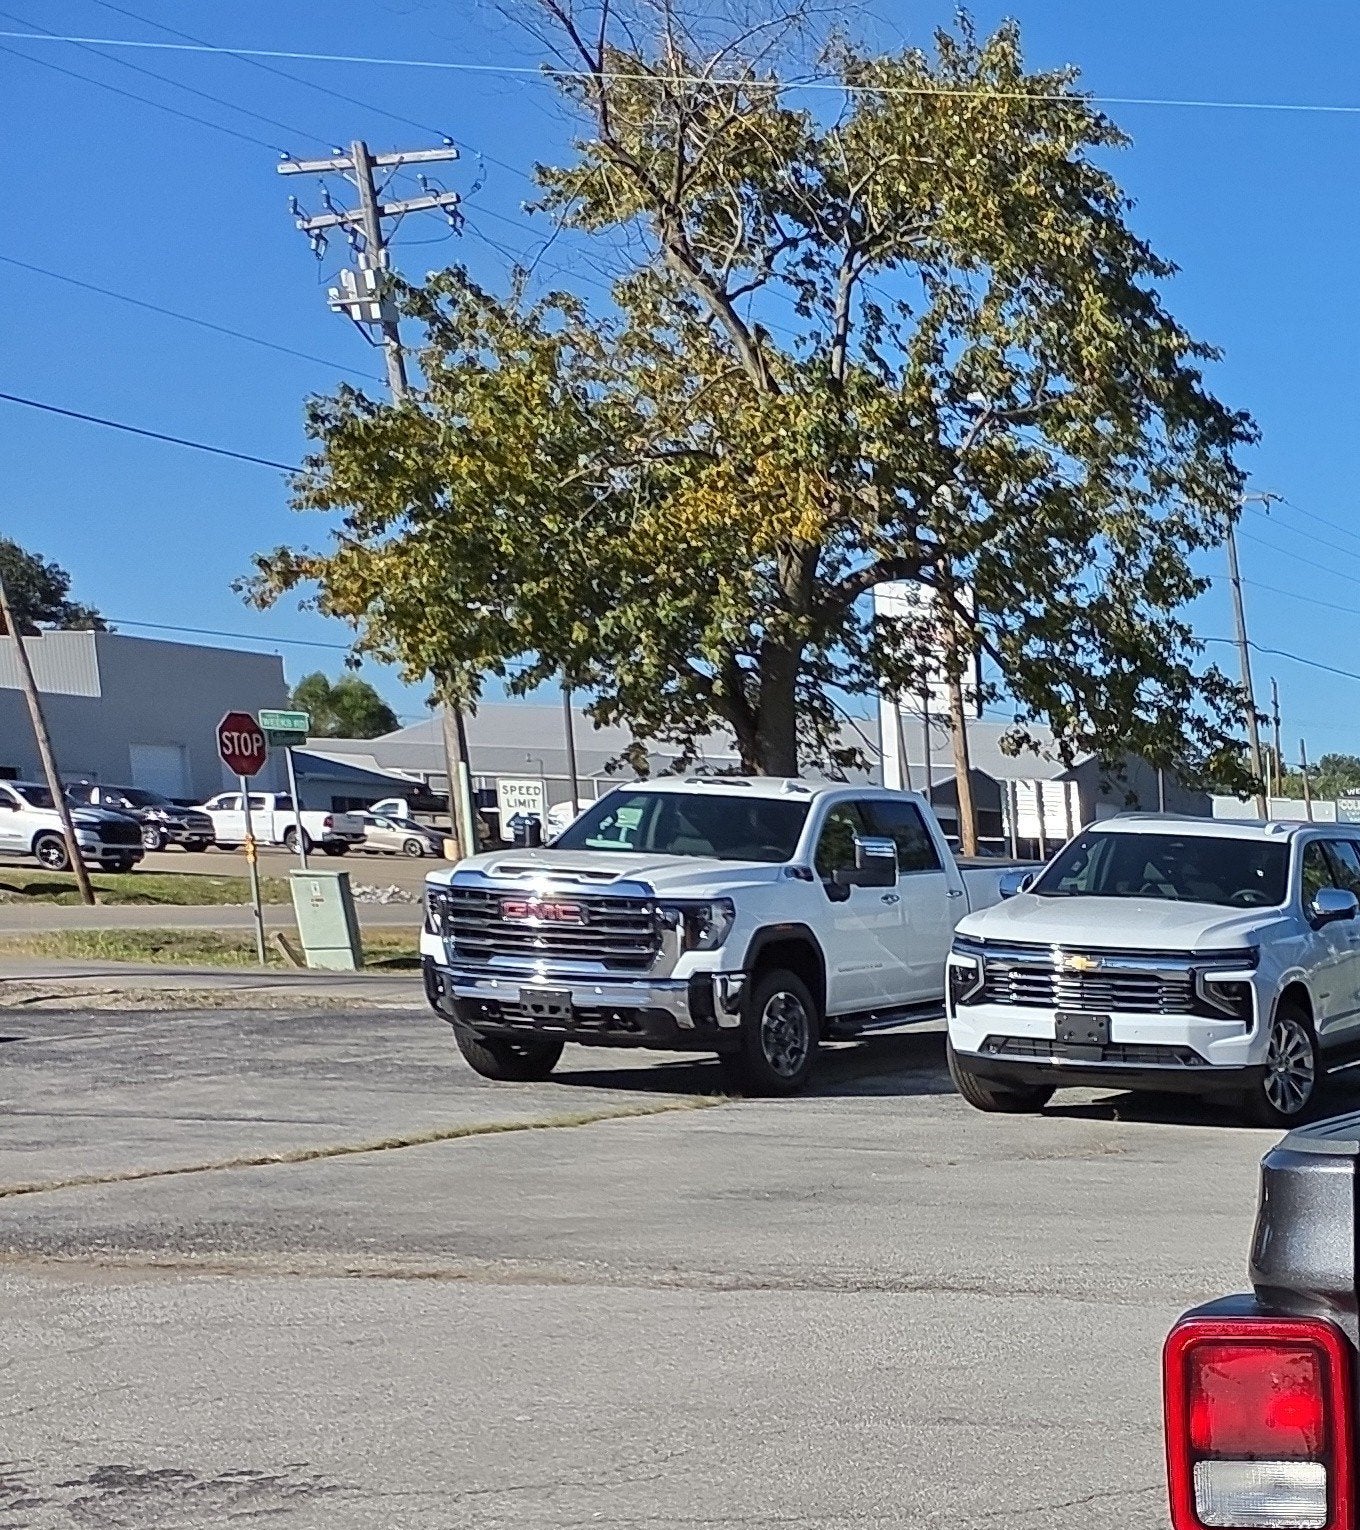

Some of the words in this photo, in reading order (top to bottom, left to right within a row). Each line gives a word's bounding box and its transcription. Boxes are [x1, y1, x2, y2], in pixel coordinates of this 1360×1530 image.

[222, 731, 263, 756] STOP
[502, 785, 541, 796] SPEED
[507, 798, 538, 808] LIMIT
[502, 901, 581, 920] GMC
